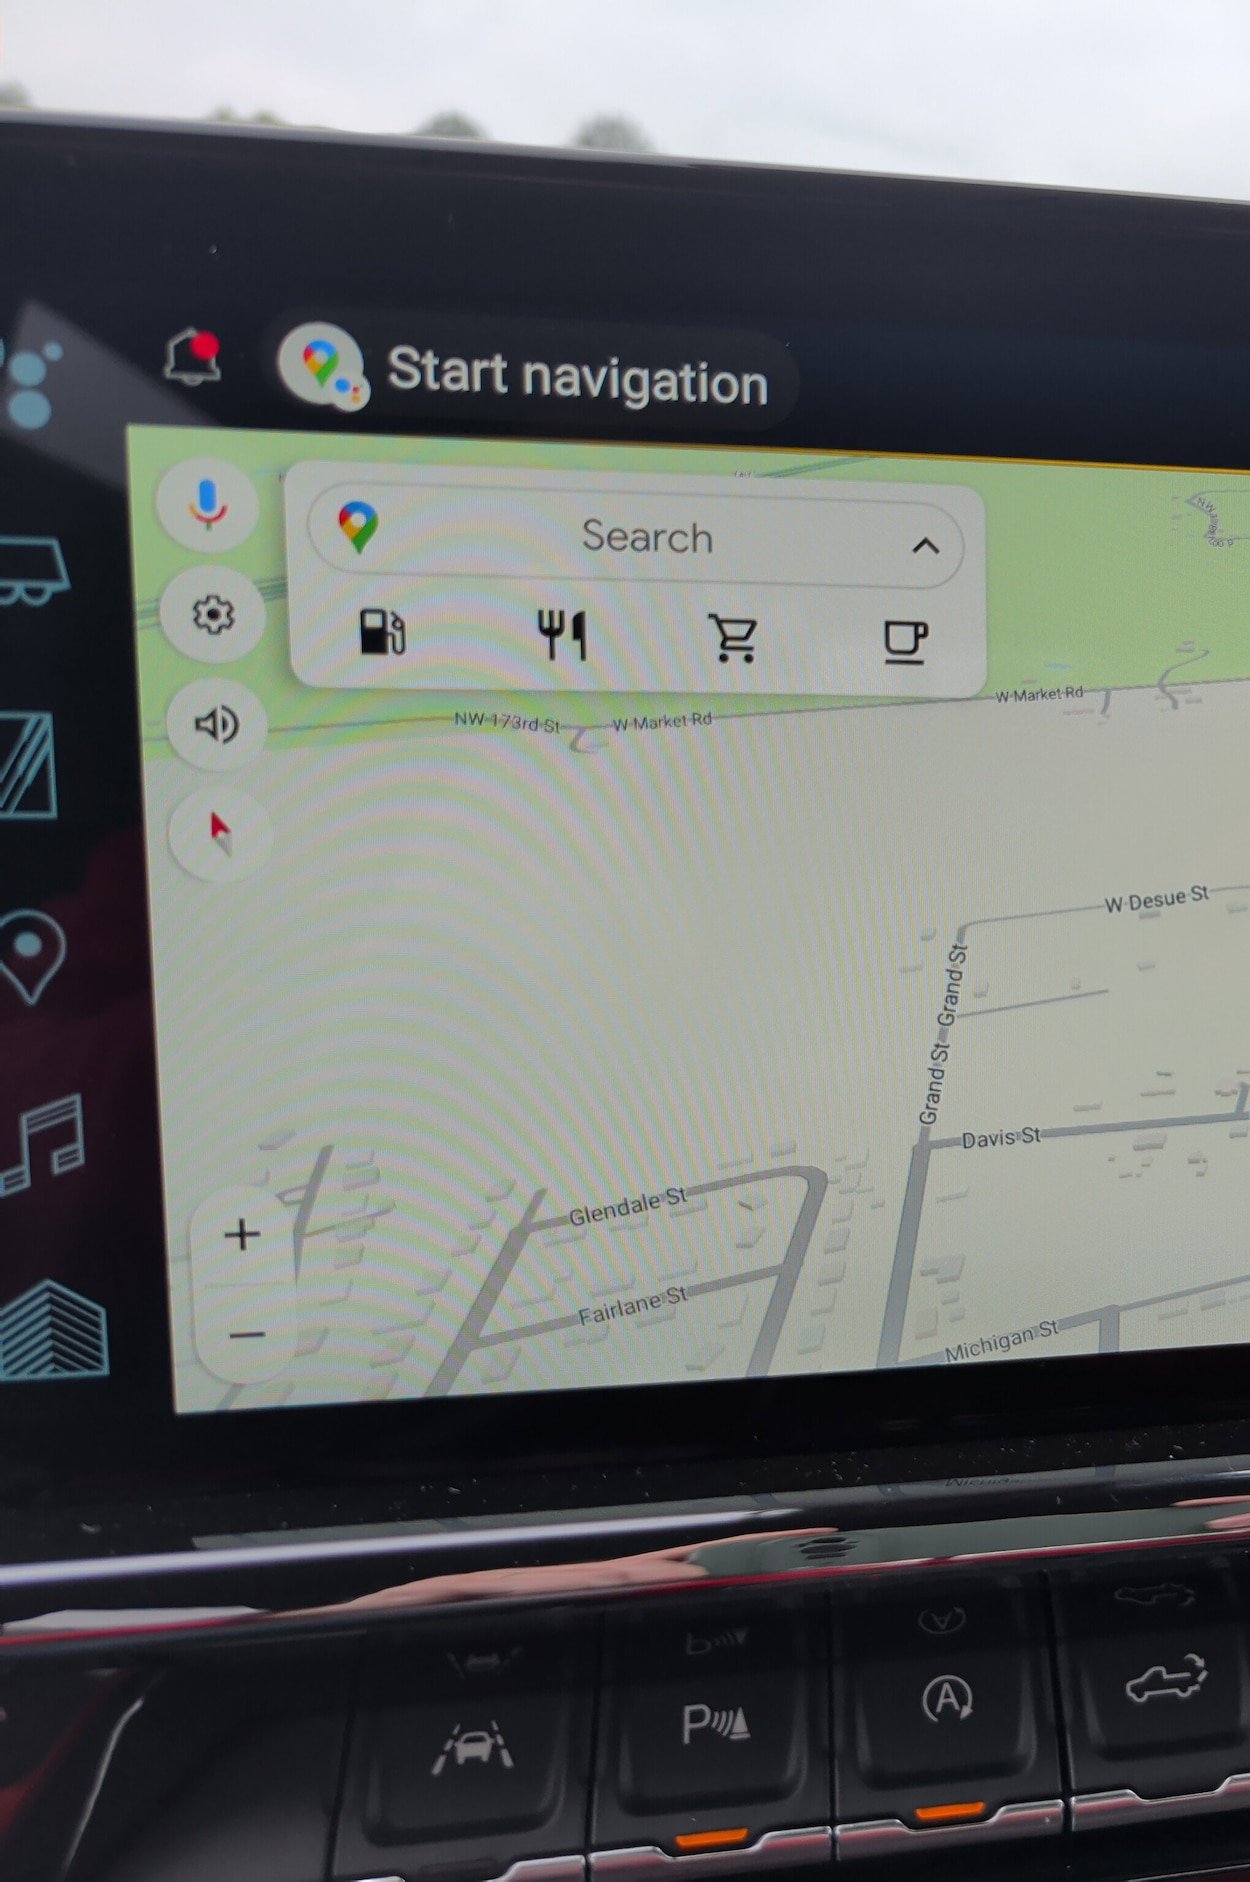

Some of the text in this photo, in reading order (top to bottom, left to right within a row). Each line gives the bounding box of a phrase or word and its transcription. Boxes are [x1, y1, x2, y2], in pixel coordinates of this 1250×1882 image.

[388, 345, 769, 410] Start navigation
[582, 518, 714, 555] Search
[995, 685, 1083, 703] W Market Rd
[454, 712, 561, 734] NW 173rd St
[612, 712, 713, 732] W Market Rd
[1105, 885, 1210, 914] W Desue St
[936, 942, 968, 1027] Grand St
[919, 1041, 951, 1126] Grand St
[961, 1125, 1042, 1149] Davis St
[568, 1186, 688, 1228] Glendale St
[577, 1285, 688, 1327] Fairlane St
[944, 1318, 1060, 1363] Michigan St
[682, 1706, 711, 1745] P
